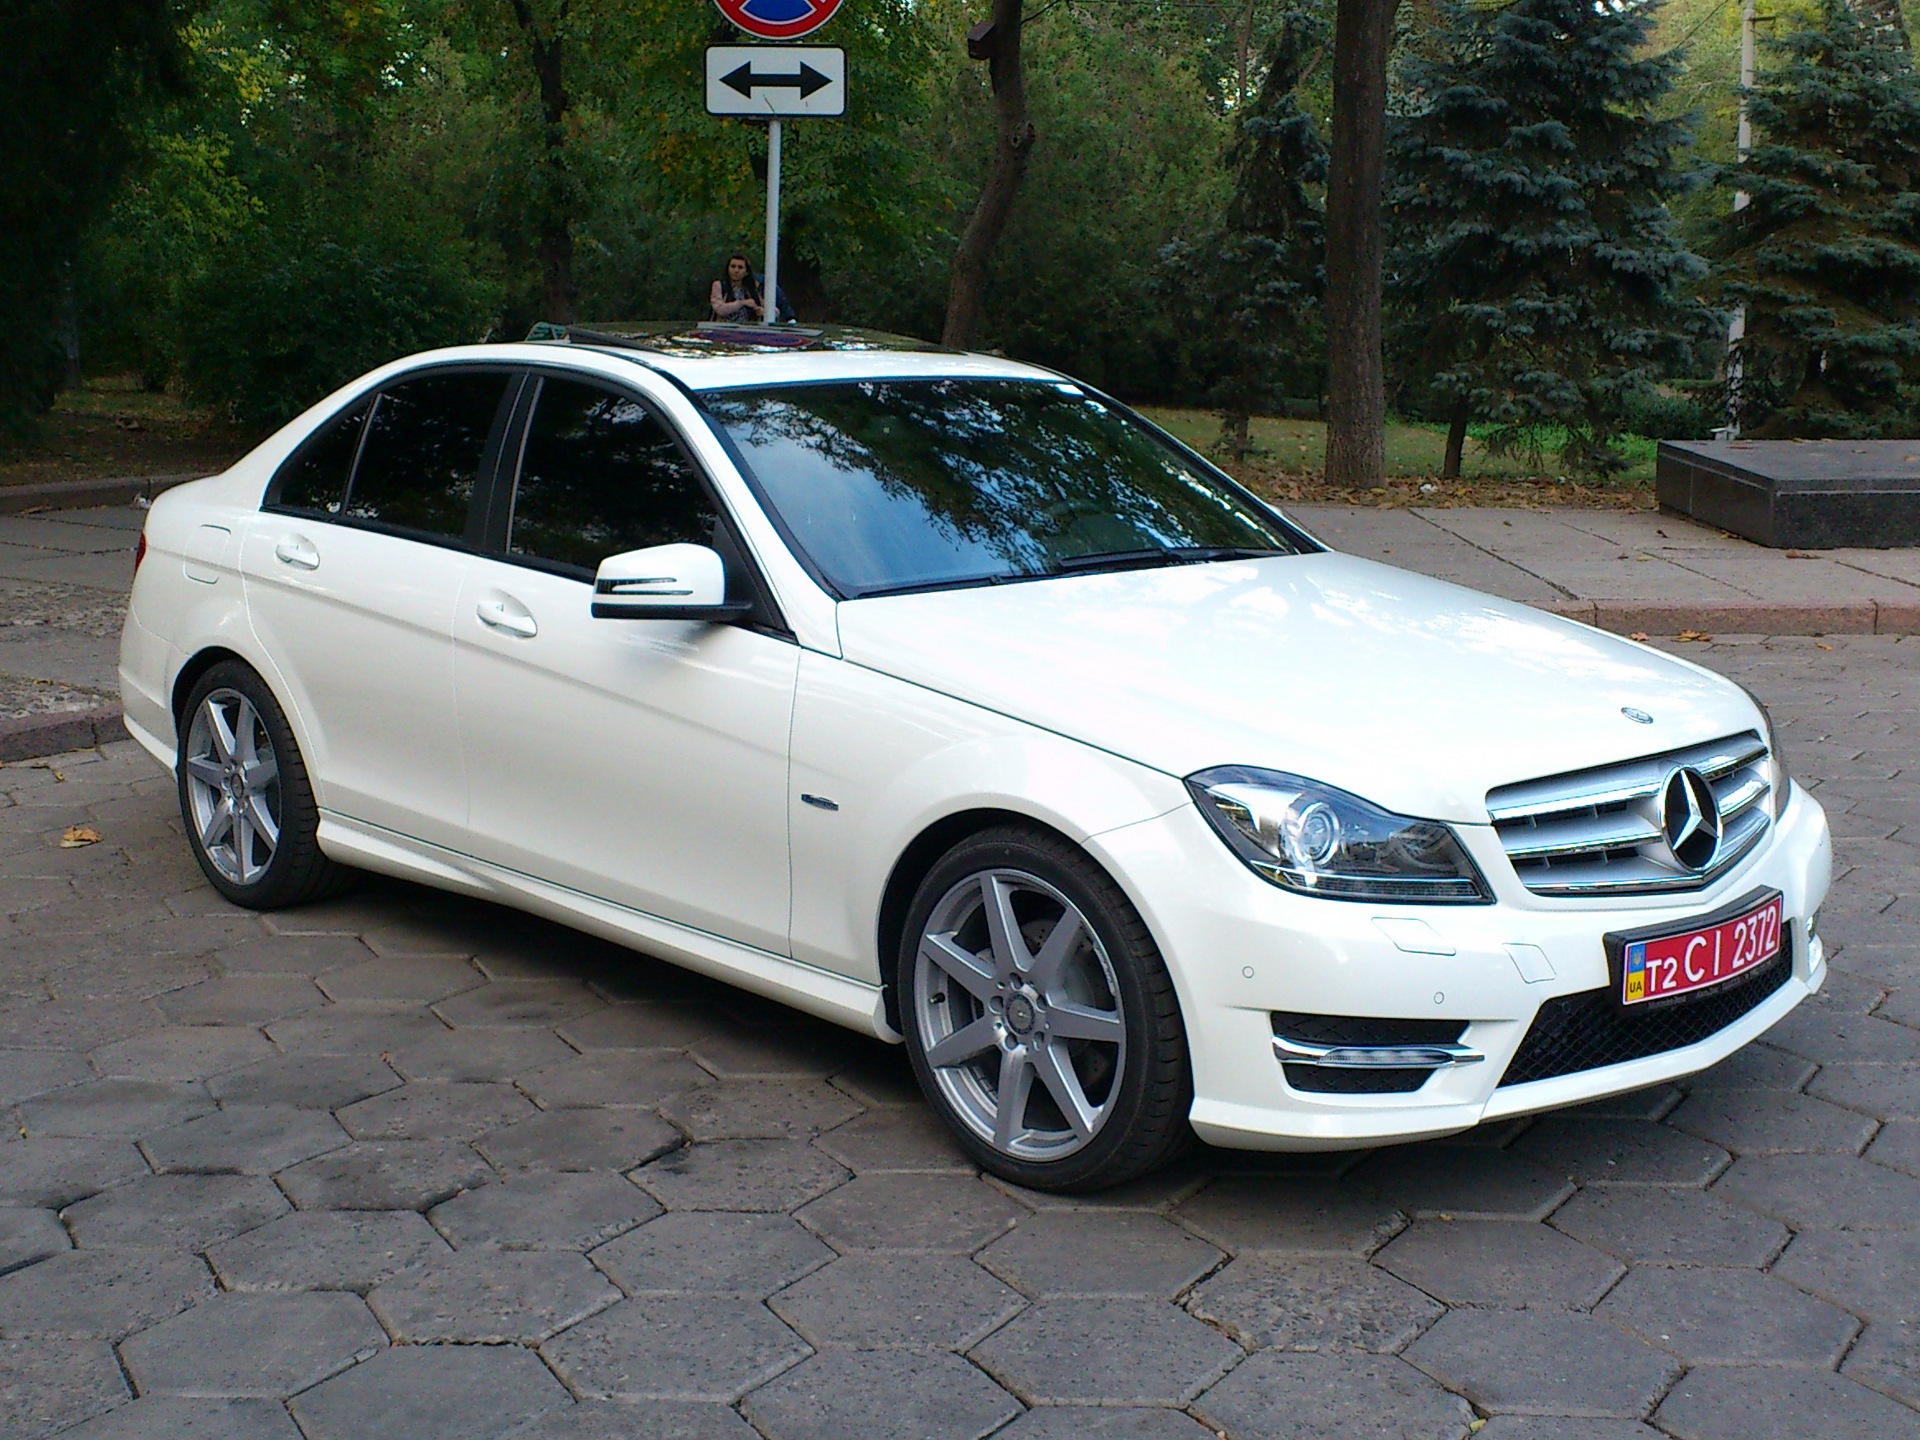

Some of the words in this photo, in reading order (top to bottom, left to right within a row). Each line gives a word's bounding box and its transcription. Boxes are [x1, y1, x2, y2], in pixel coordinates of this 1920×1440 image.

[1646, 956, 1678, 992] T2
[1732, 905, 1776, 969] 2372
[1629, 981, 1643, 993] UA
